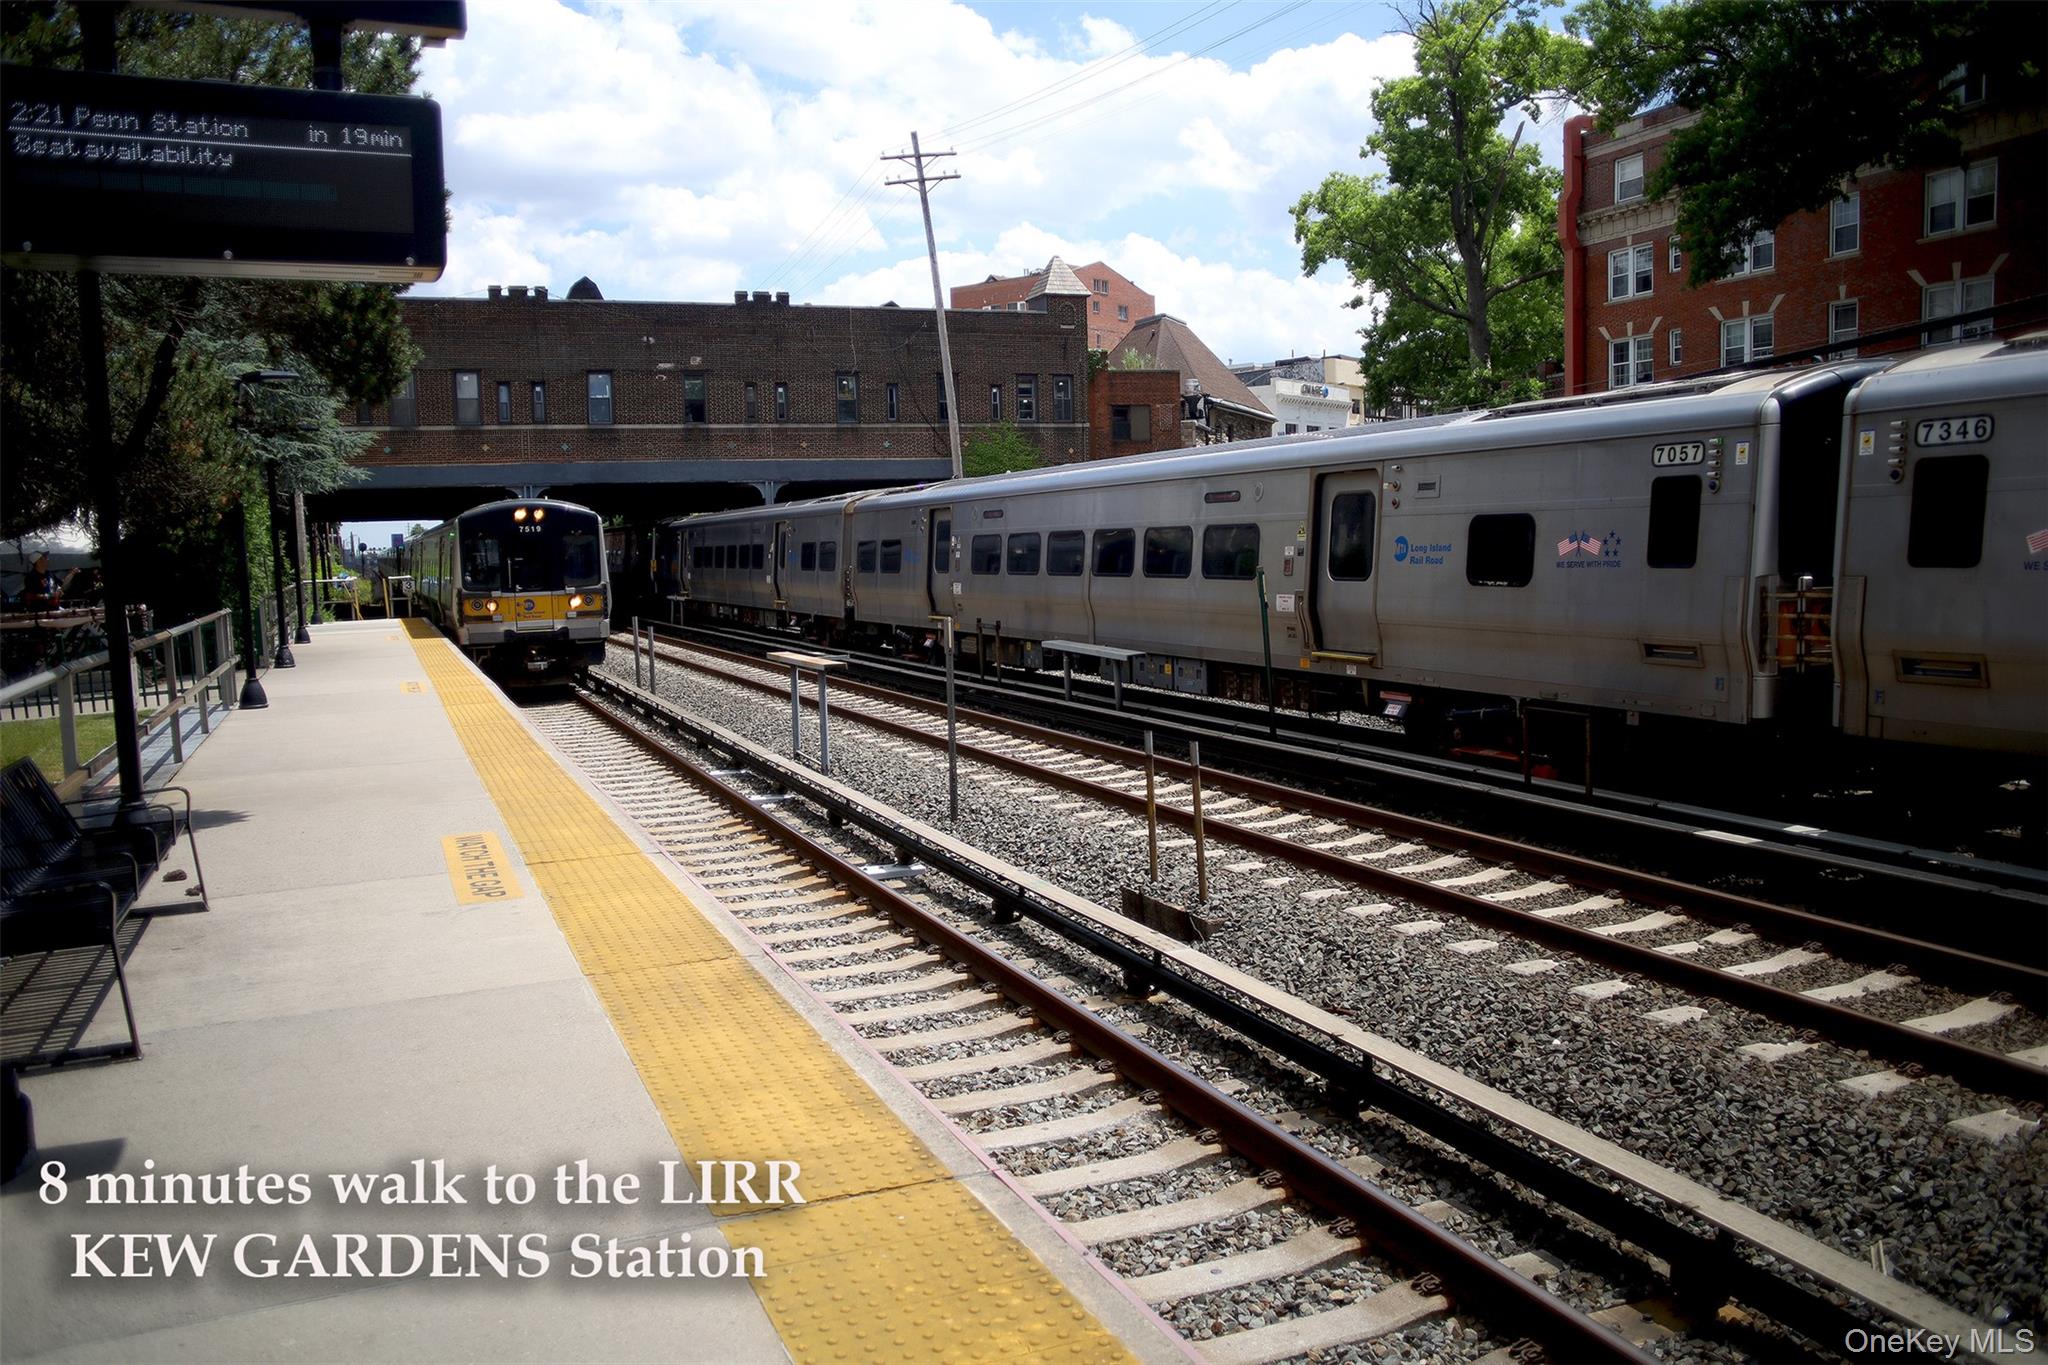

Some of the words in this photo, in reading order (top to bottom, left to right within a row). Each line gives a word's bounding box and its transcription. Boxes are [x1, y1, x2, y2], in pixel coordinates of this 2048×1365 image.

[11, 101, 64, 124] 2:21
[74, 105, 139, 130] Penn
[152, 113, 249, 138] Station
[307, 124, 329, 144] in
[14, 133, 80, 156] Seat
[84, 142, 233, 167] availability
[1923, 418, 1988, 443] 7346
[1656, 445, 1701, 463] 7057
[1410, 544, 1428, 554] Long
[1429, 543, 1452, 552] Island
[1409, 556, 1424, 565] Rail
[1425, 556, 1444, 565] Road
[1556, 561, 1565, 569] WE
[1566, 560, 1585, 569] SERVE
[1586, 560, 1601, 568] WITH
[1602, 560, 1622, 568] PRIDE
[2023, 561, 2041, 571] WE
[455, 834, 491, 861] WATCH
[464, 861, 498, 880] THE
[470, 880, 506, 897] GAP
